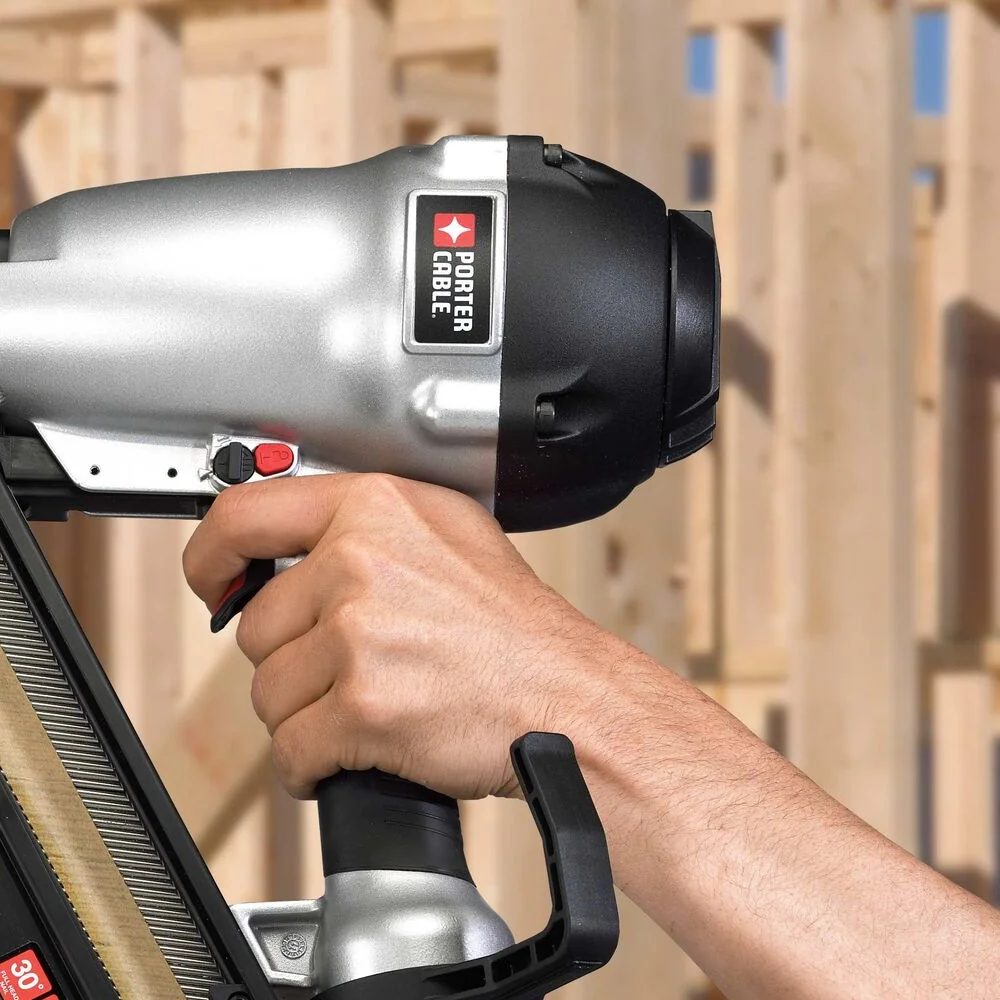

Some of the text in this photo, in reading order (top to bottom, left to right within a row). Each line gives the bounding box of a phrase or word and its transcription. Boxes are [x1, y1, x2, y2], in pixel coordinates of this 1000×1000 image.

[453, 251, 474, 332] PORTER
[0, 970, 19, 1000] FULL HEAD
